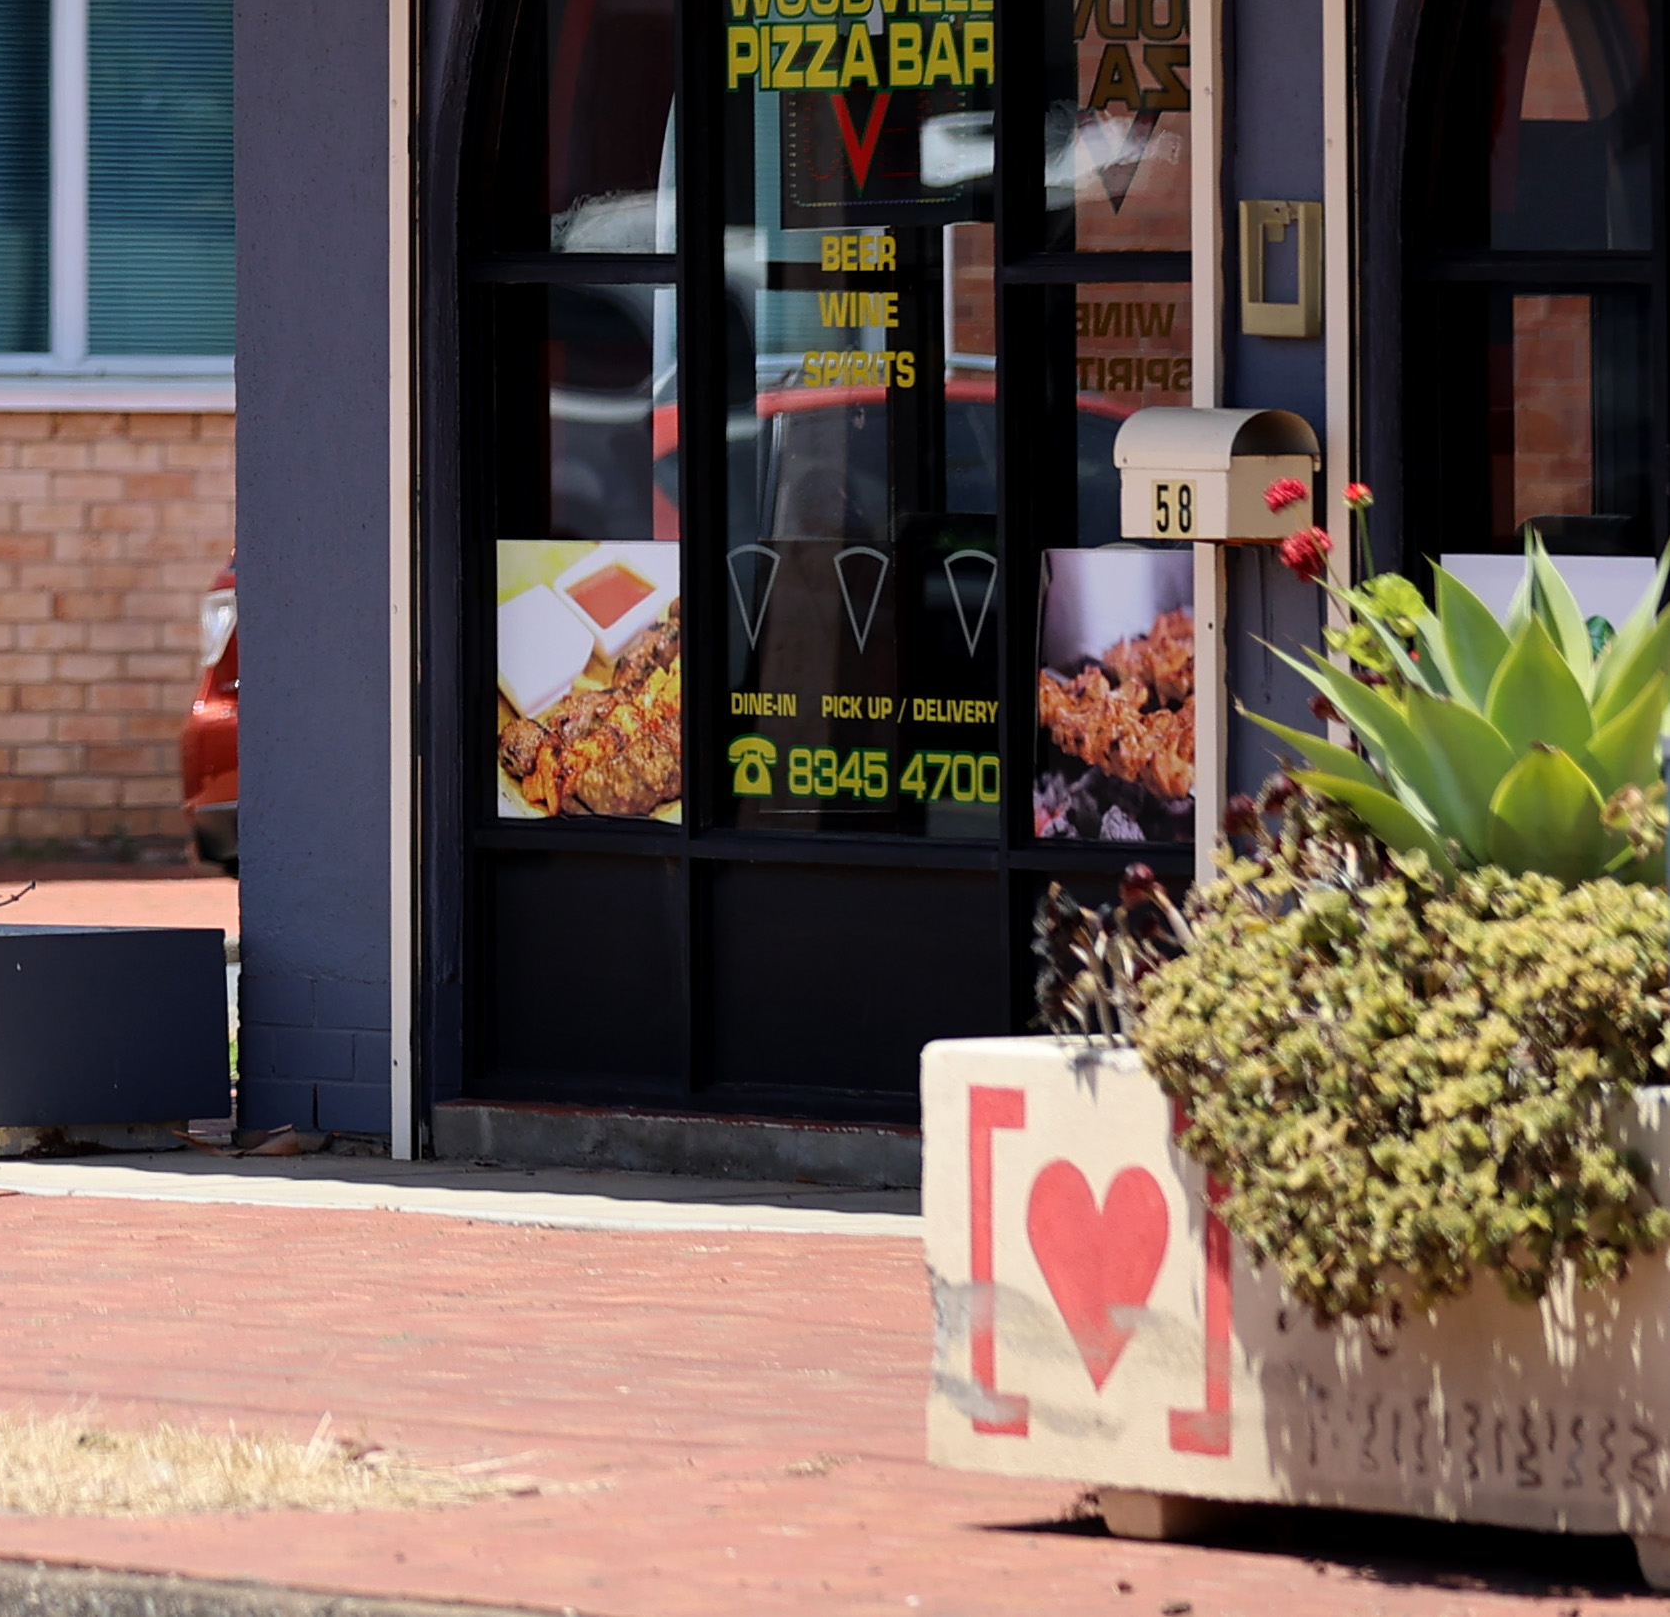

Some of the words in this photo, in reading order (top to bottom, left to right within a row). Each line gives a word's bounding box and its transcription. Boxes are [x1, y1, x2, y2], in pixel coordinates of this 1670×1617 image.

[726, 21, 880, 91] PIZZA
[888, 20, 995, 89] BAR
[821, 235, 897, 272] BEER
[818, 291, 900, 328] WINE
[802, 349, 916, 389] SPIRITS
[1156, 484, 1192, 533] 58
[731, 692, 797, 717] DINE-IN
[821, 695, 863, 719] PICK
[867, 696, 893, 720] UP
[912, 698, 999, 724] DELIVERY
[788, 746, 889, 800] 8345
[899, 750, 1001, 804] 4700
